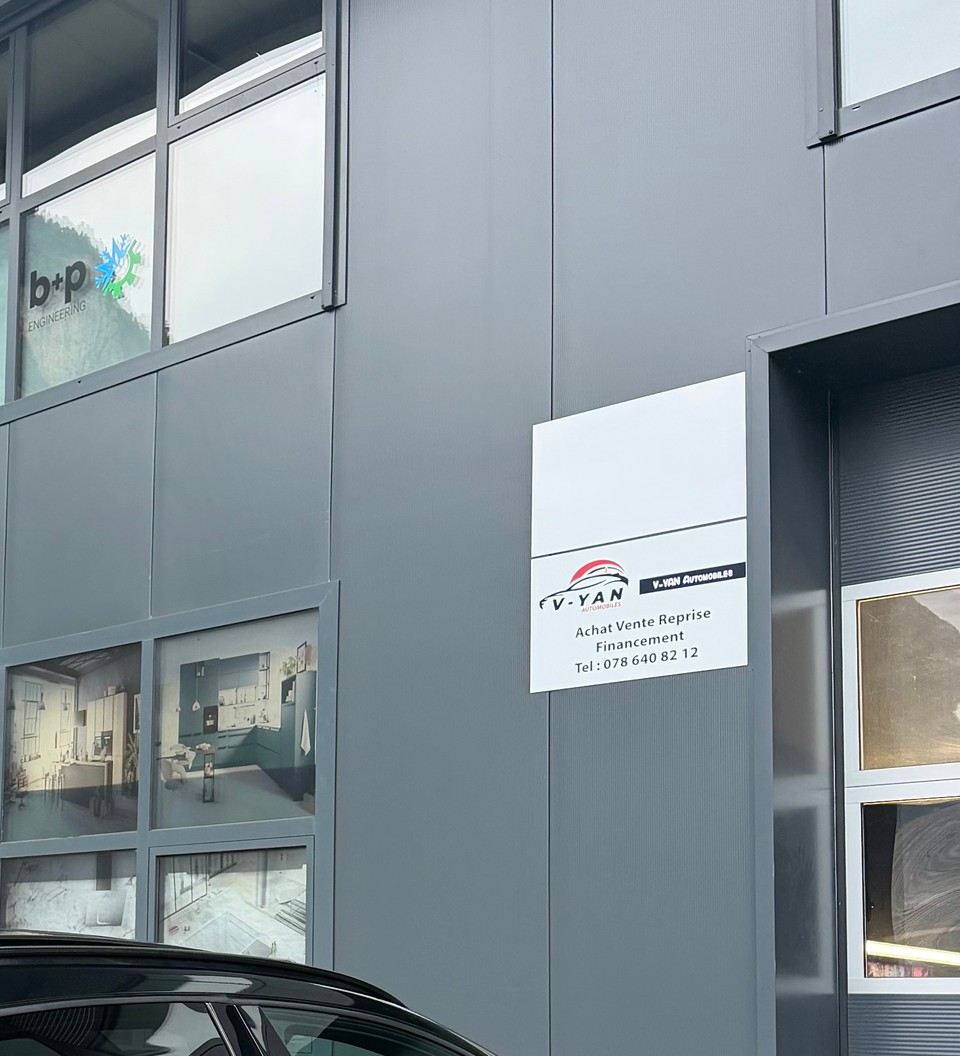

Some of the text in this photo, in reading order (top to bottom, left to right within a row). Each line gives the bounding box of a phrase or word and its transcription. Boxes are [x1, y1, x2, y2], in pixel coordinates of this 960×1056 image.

[29, 260, 87, 309] b+p
[28, 300, 87, 332] ENGINEERING
[652, 576, 681, 590] V-YAN
[581, 601, 622, 613] AUTOMOBILES
[575, 609, 711, 638] Achat Vente Reprise
[596, 631, 685, 653] Financement
[575, 660, 593, 673] Tel
[603, 657, 628, 670] 078
[632, 652, 657, 665] 640
[660, 649, 677, 662] 82
[683, 646, 698, 659] 12
